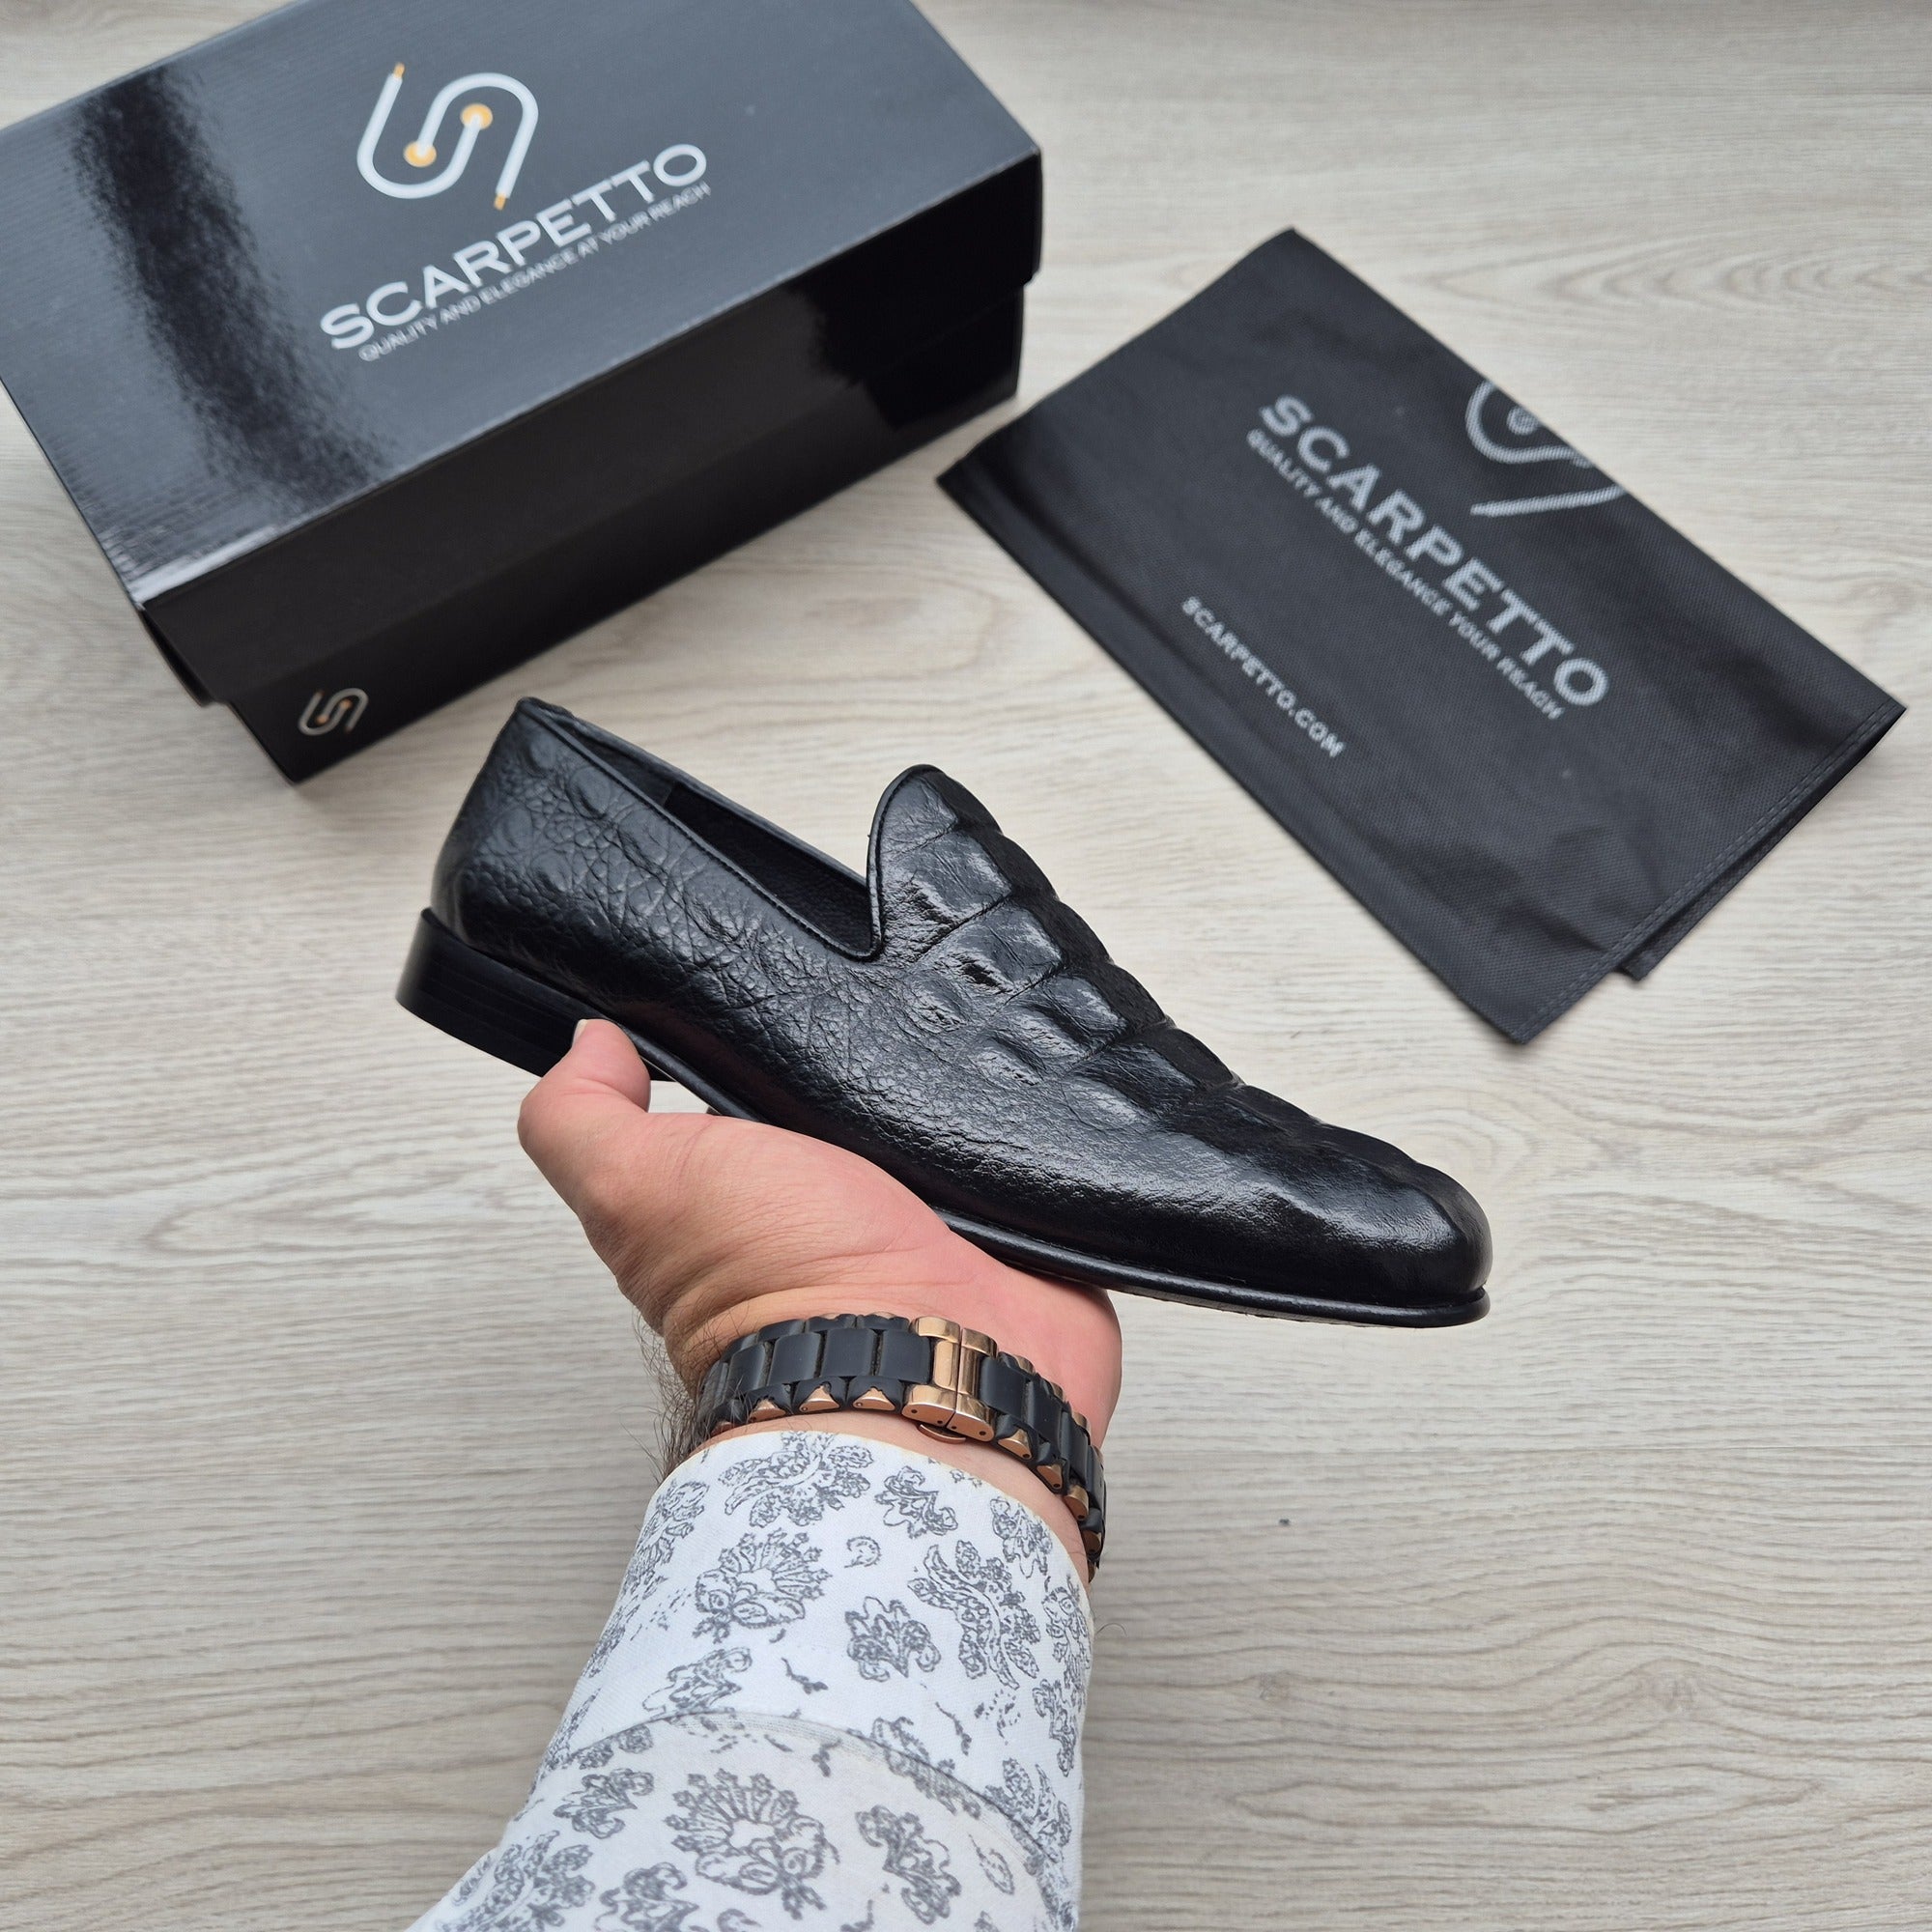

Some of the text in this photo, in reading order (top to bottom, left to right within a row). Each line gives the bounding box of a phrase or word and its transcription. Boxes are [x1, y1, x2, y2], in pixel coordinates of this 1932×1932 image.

[320, 143, 707, 350] SCARPETTO
[358, 181, 711, 361] QUALITY AND ELEGANCE AT YOUR REACH
[1246, 428, 1564, 719] QUALITY AND ELEGANCE YOUR REACH
[1259, 394, 1608, 706] SCARPETTO
[1182, 596, 1346, 757] SCARPETTO.COM
